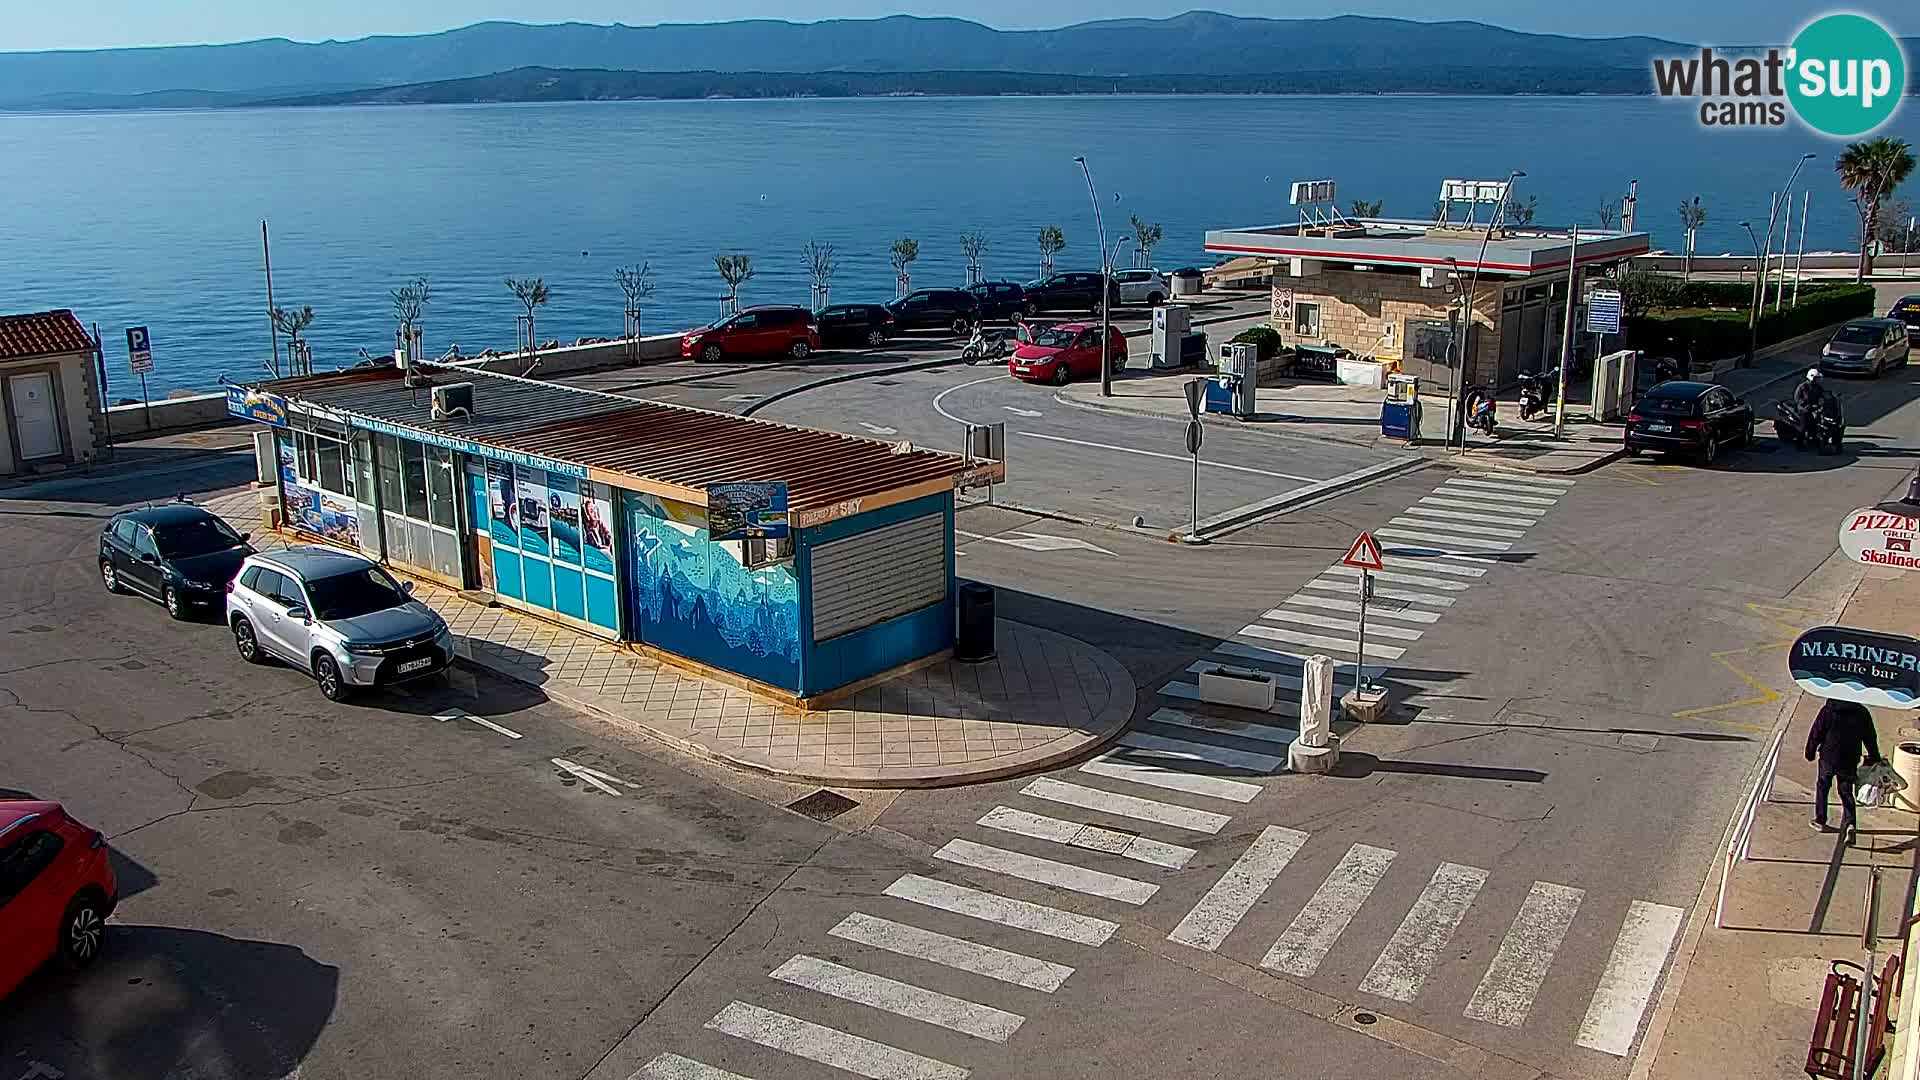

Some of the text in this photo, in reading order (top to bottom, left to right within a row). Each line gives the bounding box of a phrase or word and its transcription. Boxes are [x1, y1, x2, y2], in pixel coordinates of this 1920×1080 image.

[131, 330, 144, 349] P
[397, 426, 437, 443] AUTOBUSNA
[437, 435, 469, 451] POSTAJA
[479, 445, 494, 456] BUS
[494, 448, 527, 464] STATION
[530, 457, 556, 470] TICKET
[556, 462, 584, 476] OFFICE
[1848, 515, 1920, 532] PIZZE
[1882, 529, 1918, 540] GRILL
[1829, 661, 1899, 680] caffe bar
